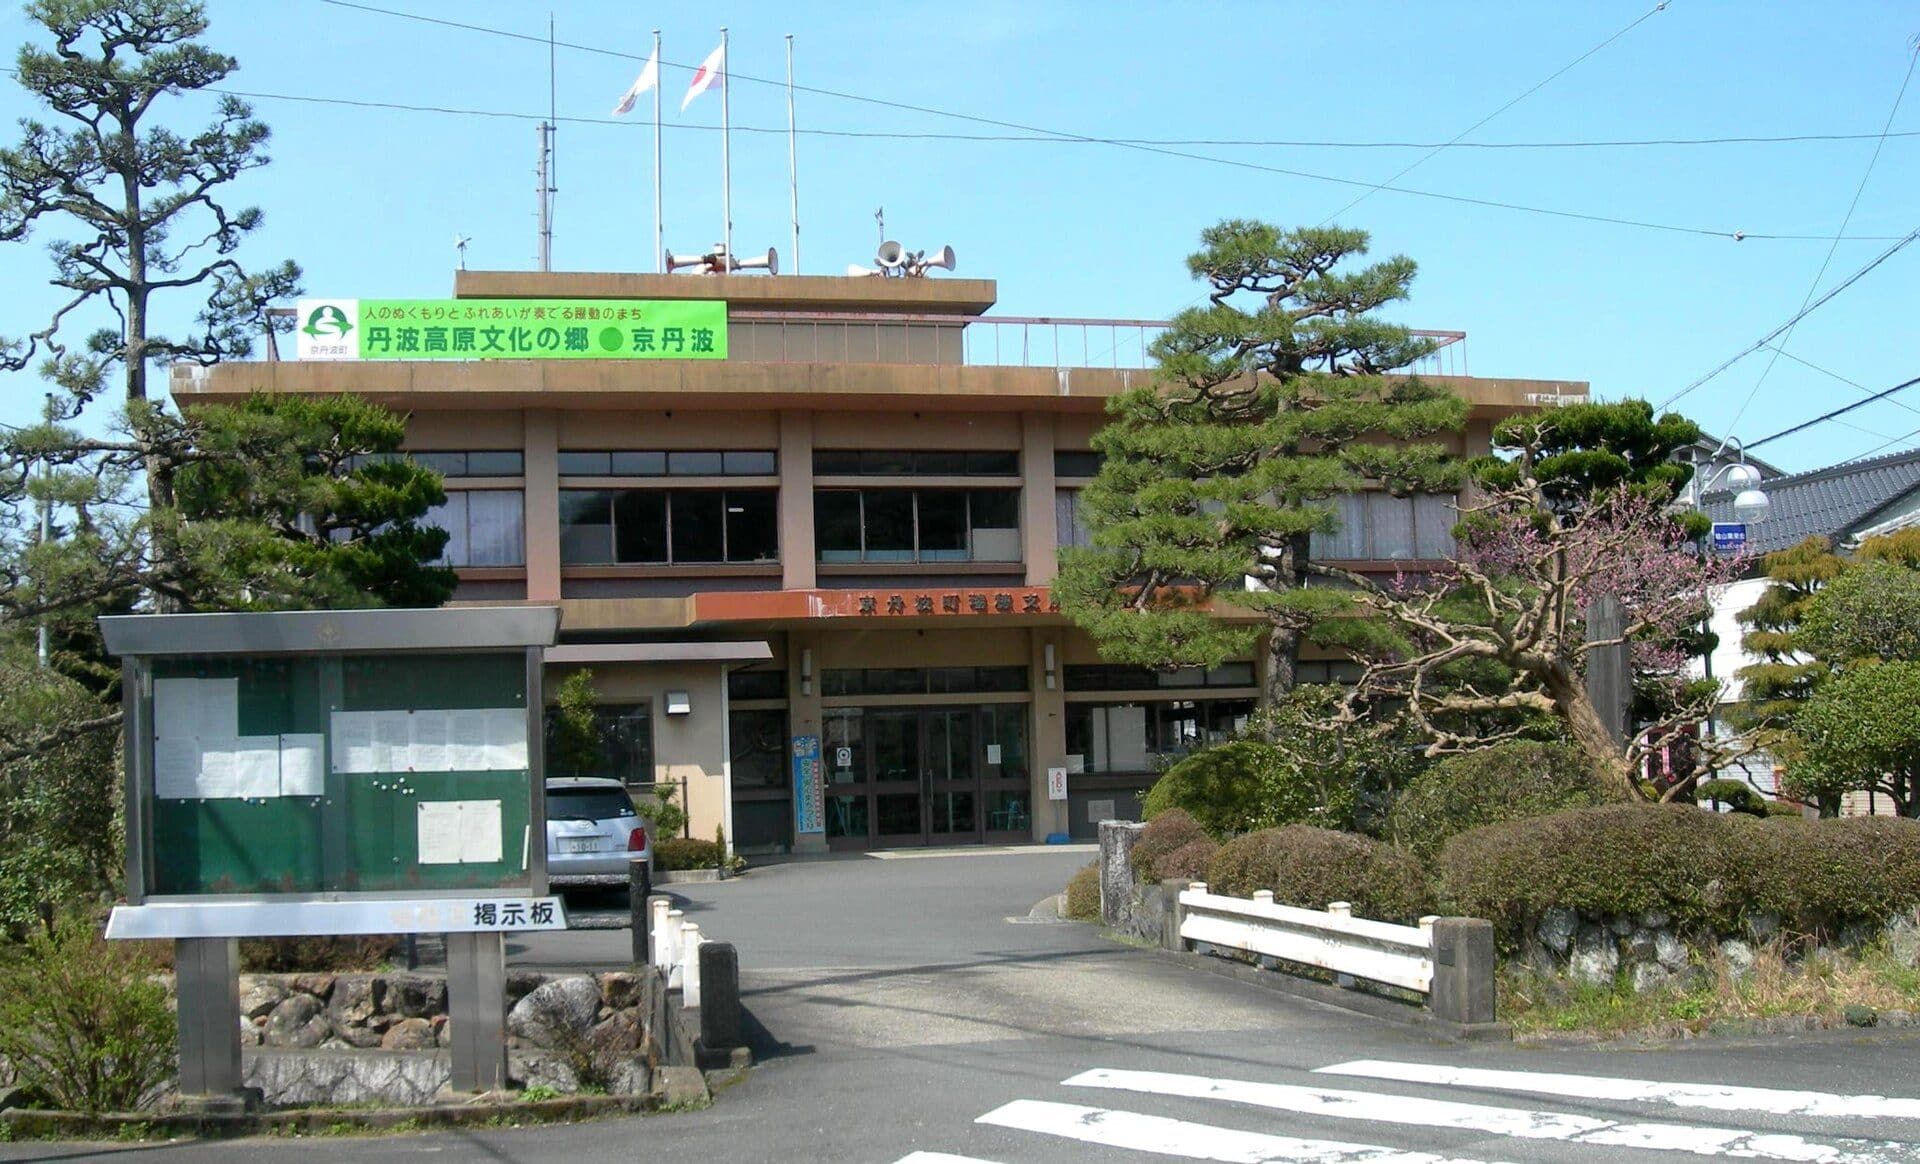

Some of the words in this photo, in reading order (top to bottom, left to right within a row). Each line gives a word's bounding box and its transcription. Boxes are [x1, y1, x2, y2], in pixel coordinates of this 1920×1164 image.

[310, 344, 348, 355] 京丹波町
[366, 327, 589, 353] 丹波高原文化の郷
[631, 327, 715, 353] 京丹波
[473, 901, 555, 927] 掲示板
